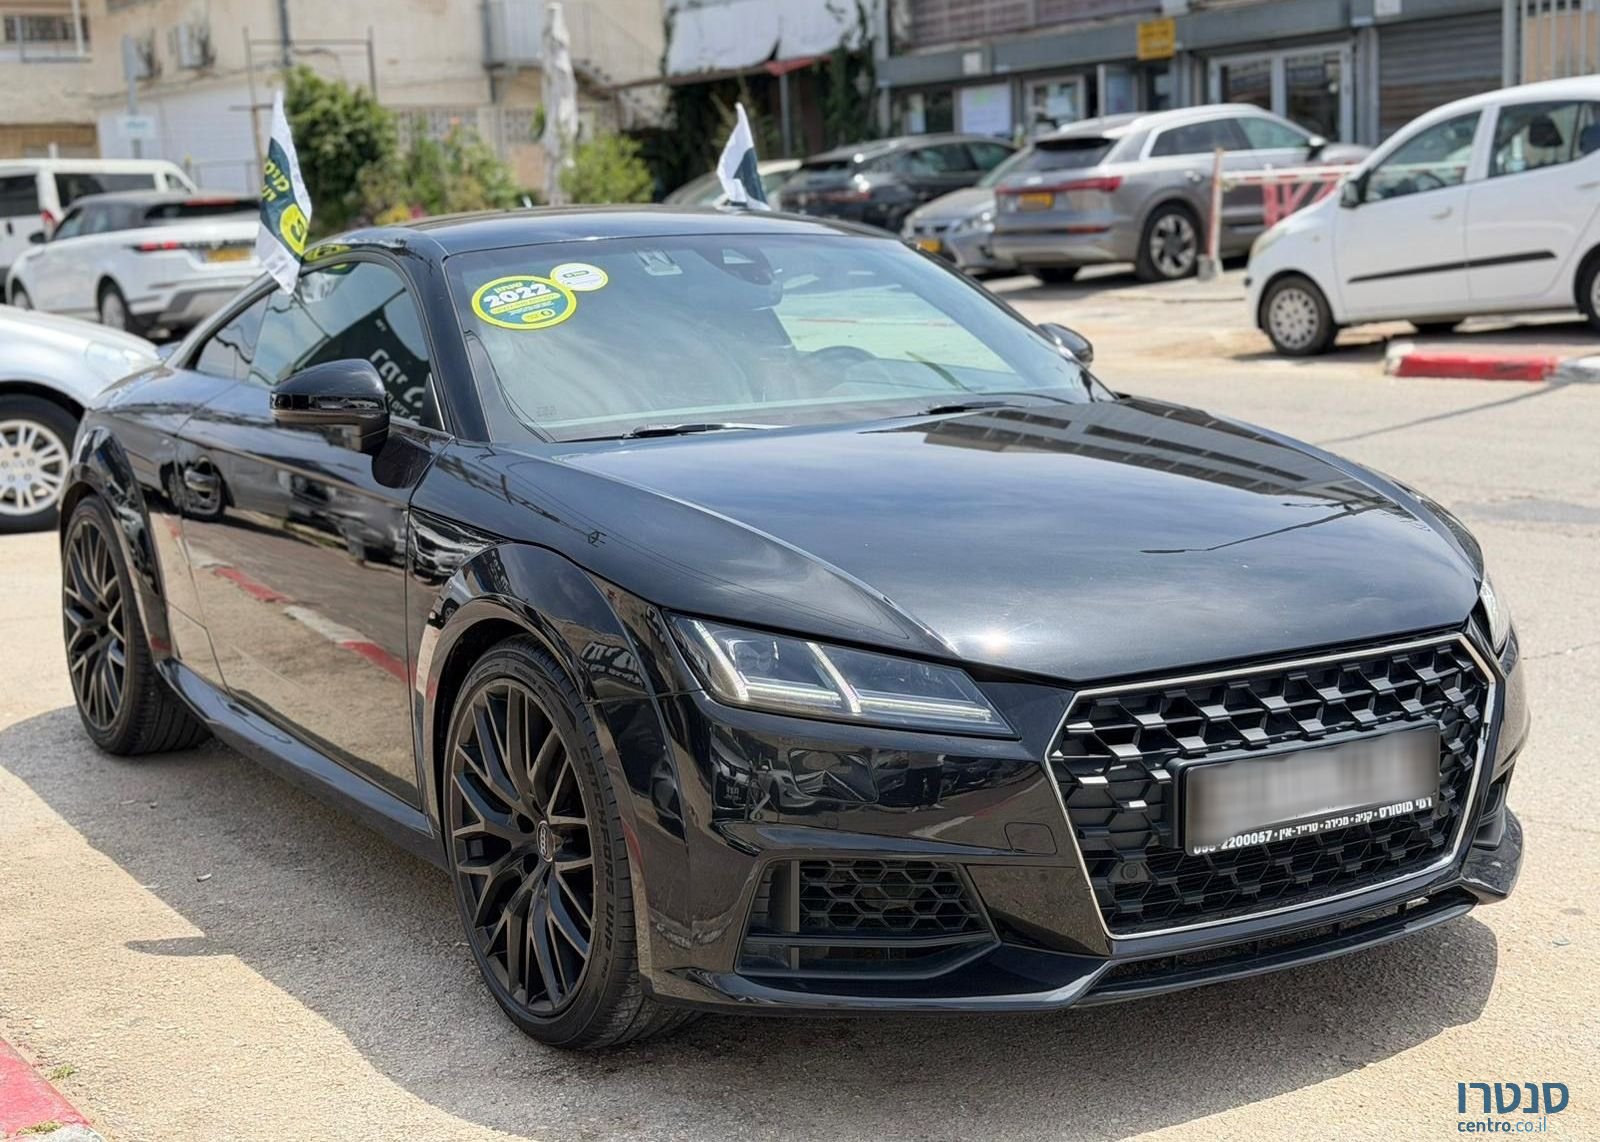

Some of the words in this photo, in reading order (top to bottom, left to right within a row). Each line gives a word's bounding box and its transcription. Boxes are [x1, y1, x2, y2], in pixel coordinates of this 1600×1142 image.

[483, 283, 551, 308] 2022
[1379, 801, 1413, 818] מוטורס
[1416, 797, 1432, 809] רמי
[1325, 816, 1349, 829] מכירה
[1355, 811, 1373, 823] קניה
